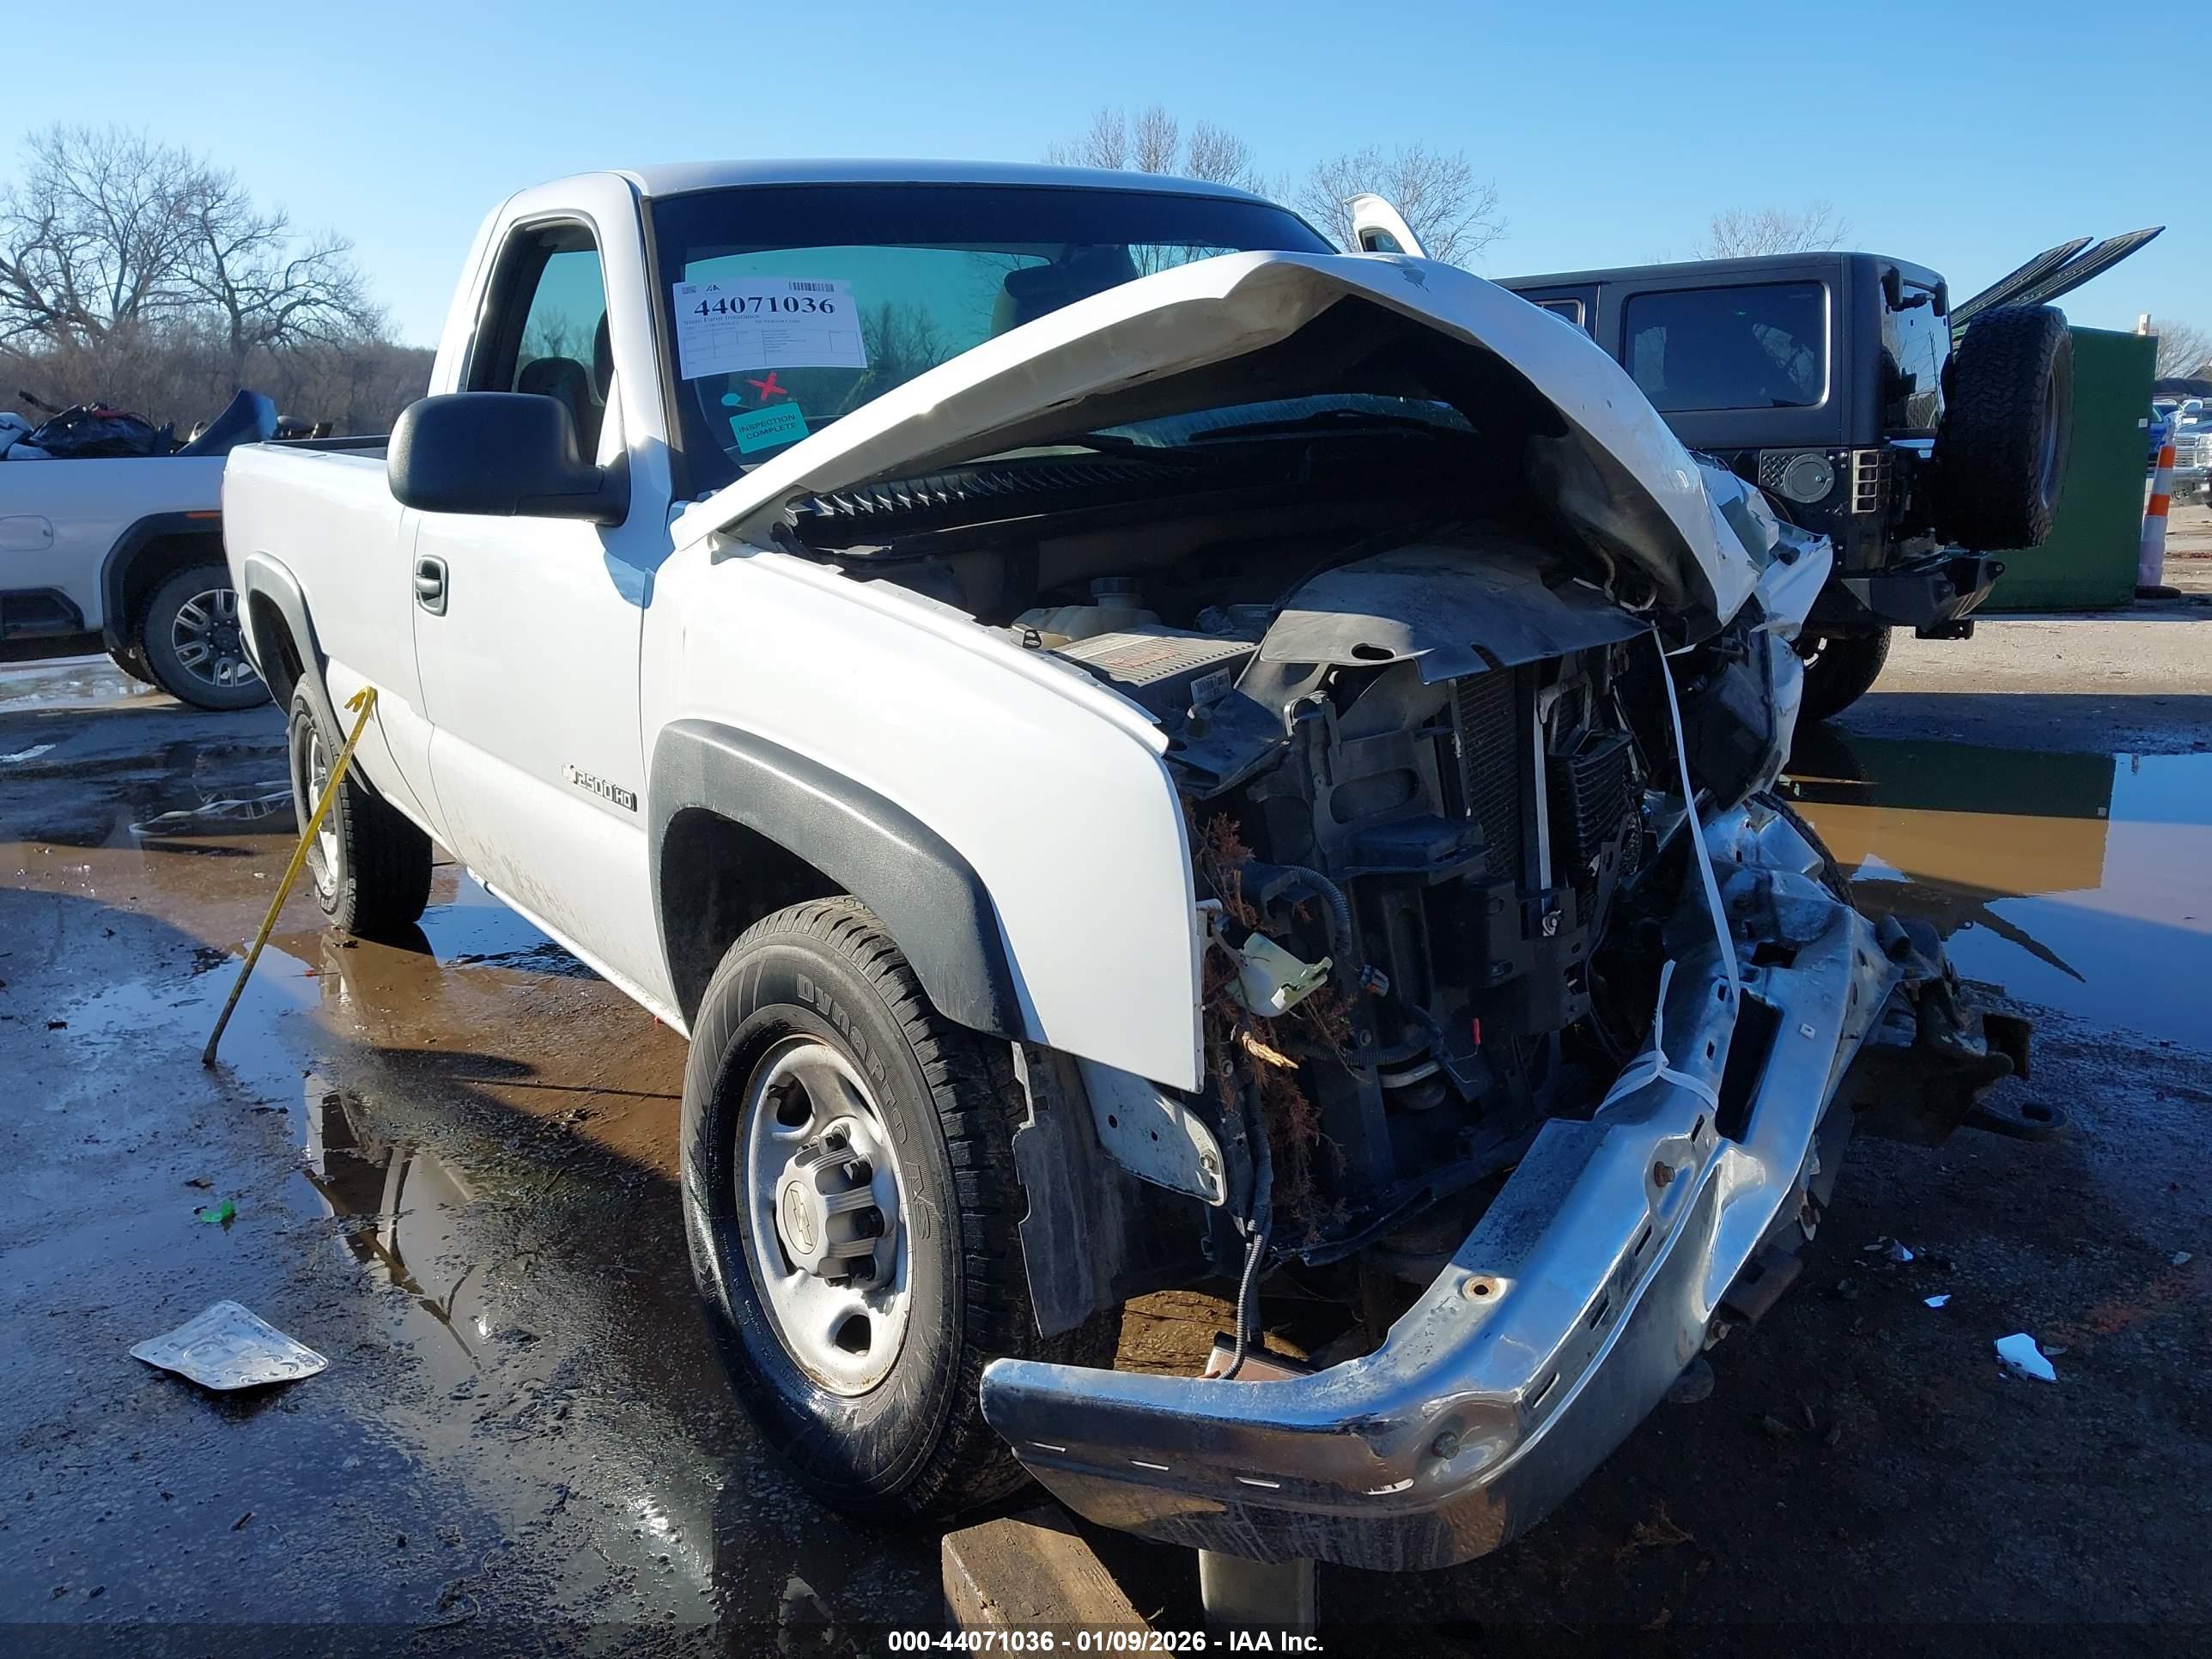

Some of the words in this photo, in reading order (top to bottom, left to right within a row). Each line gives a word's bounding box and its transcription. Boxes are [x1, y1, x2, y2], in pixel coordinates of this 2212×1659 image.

[694, 295, 836, 316] 44071036
[738, 413, 796, 434] INSPECTION
[746, 422, 796, 440] COMPLETE
[615, 787, 634, 811] HD
